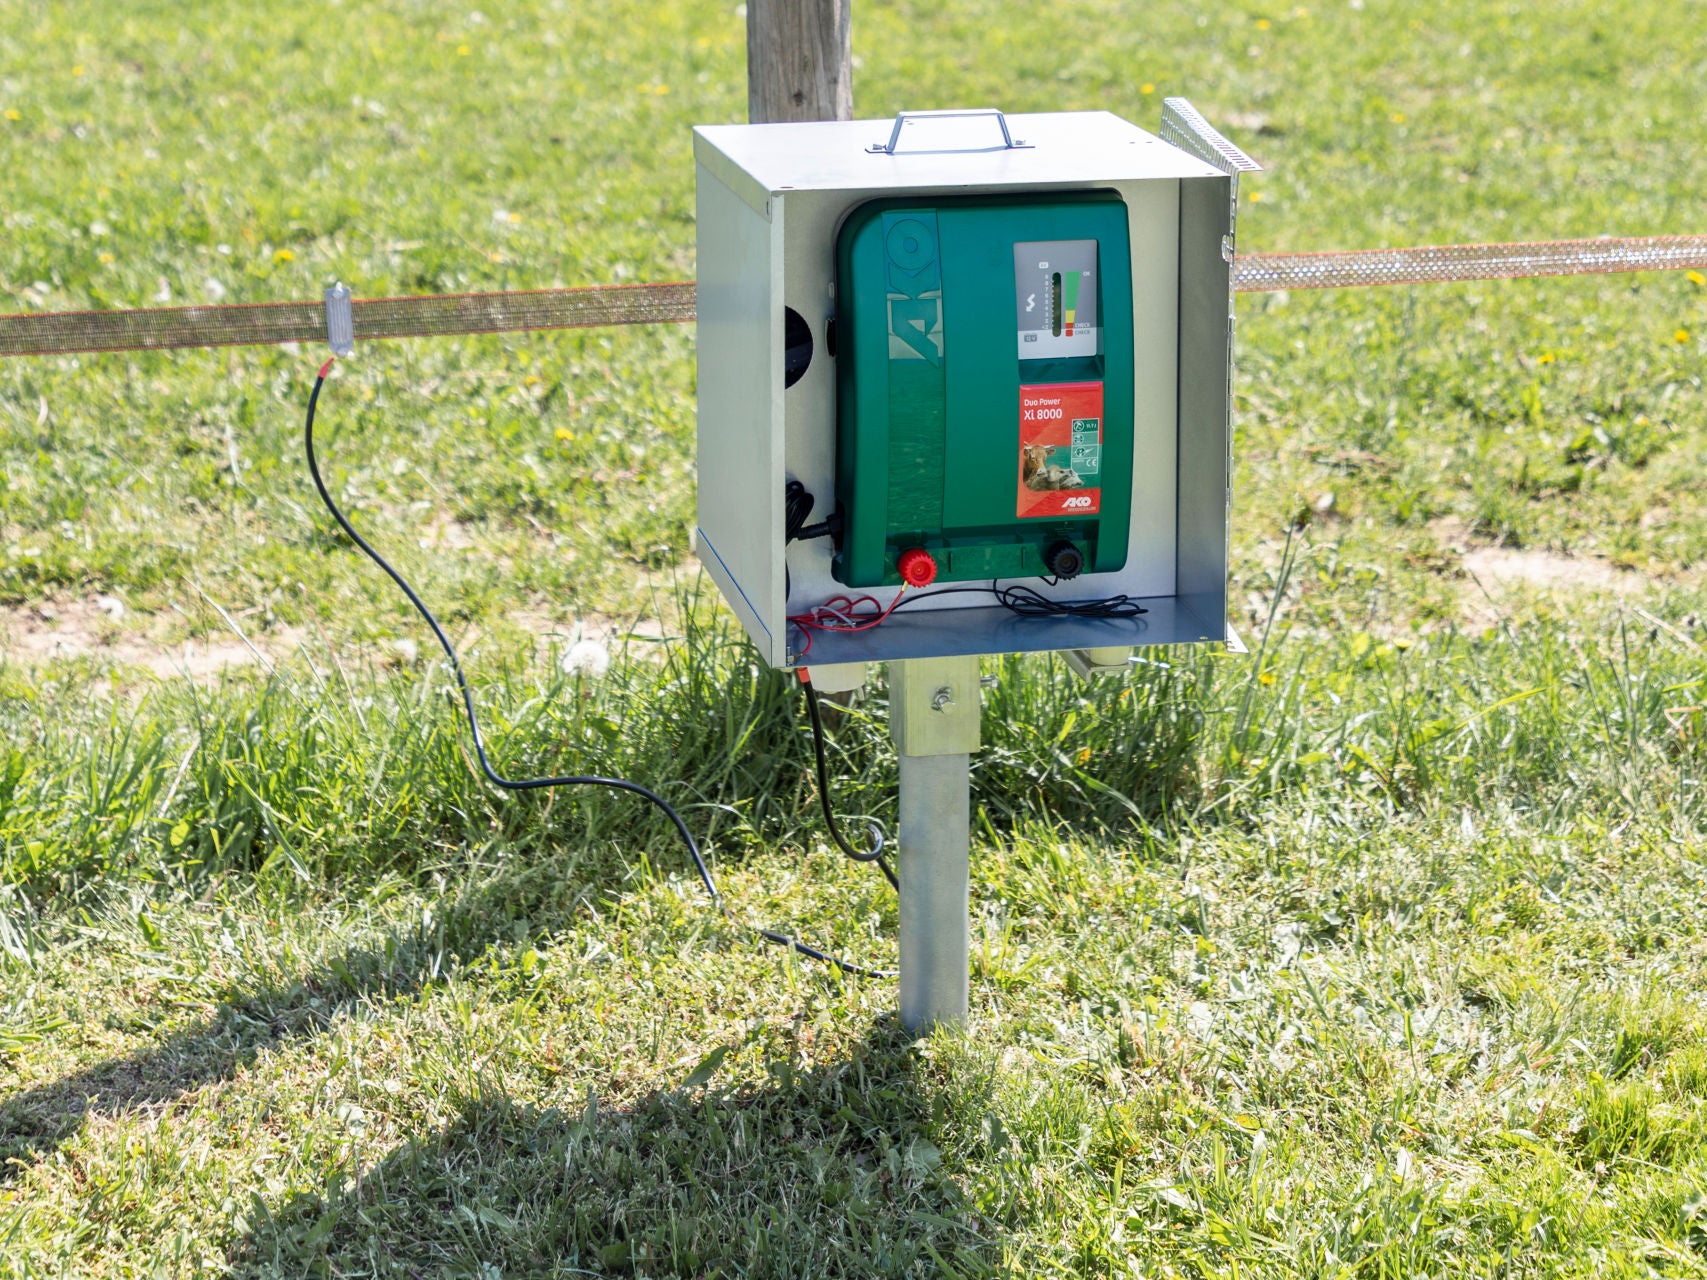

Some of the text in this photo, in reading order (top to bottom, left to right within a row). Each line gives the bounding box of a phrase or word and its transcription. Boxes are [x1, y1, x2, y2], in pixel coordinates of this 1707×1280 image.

[1040, 398, 1061, 406] Power
[1024, 408, 1062, 420] Xi 8000
[1061, 496, 1091, 508] AKO
